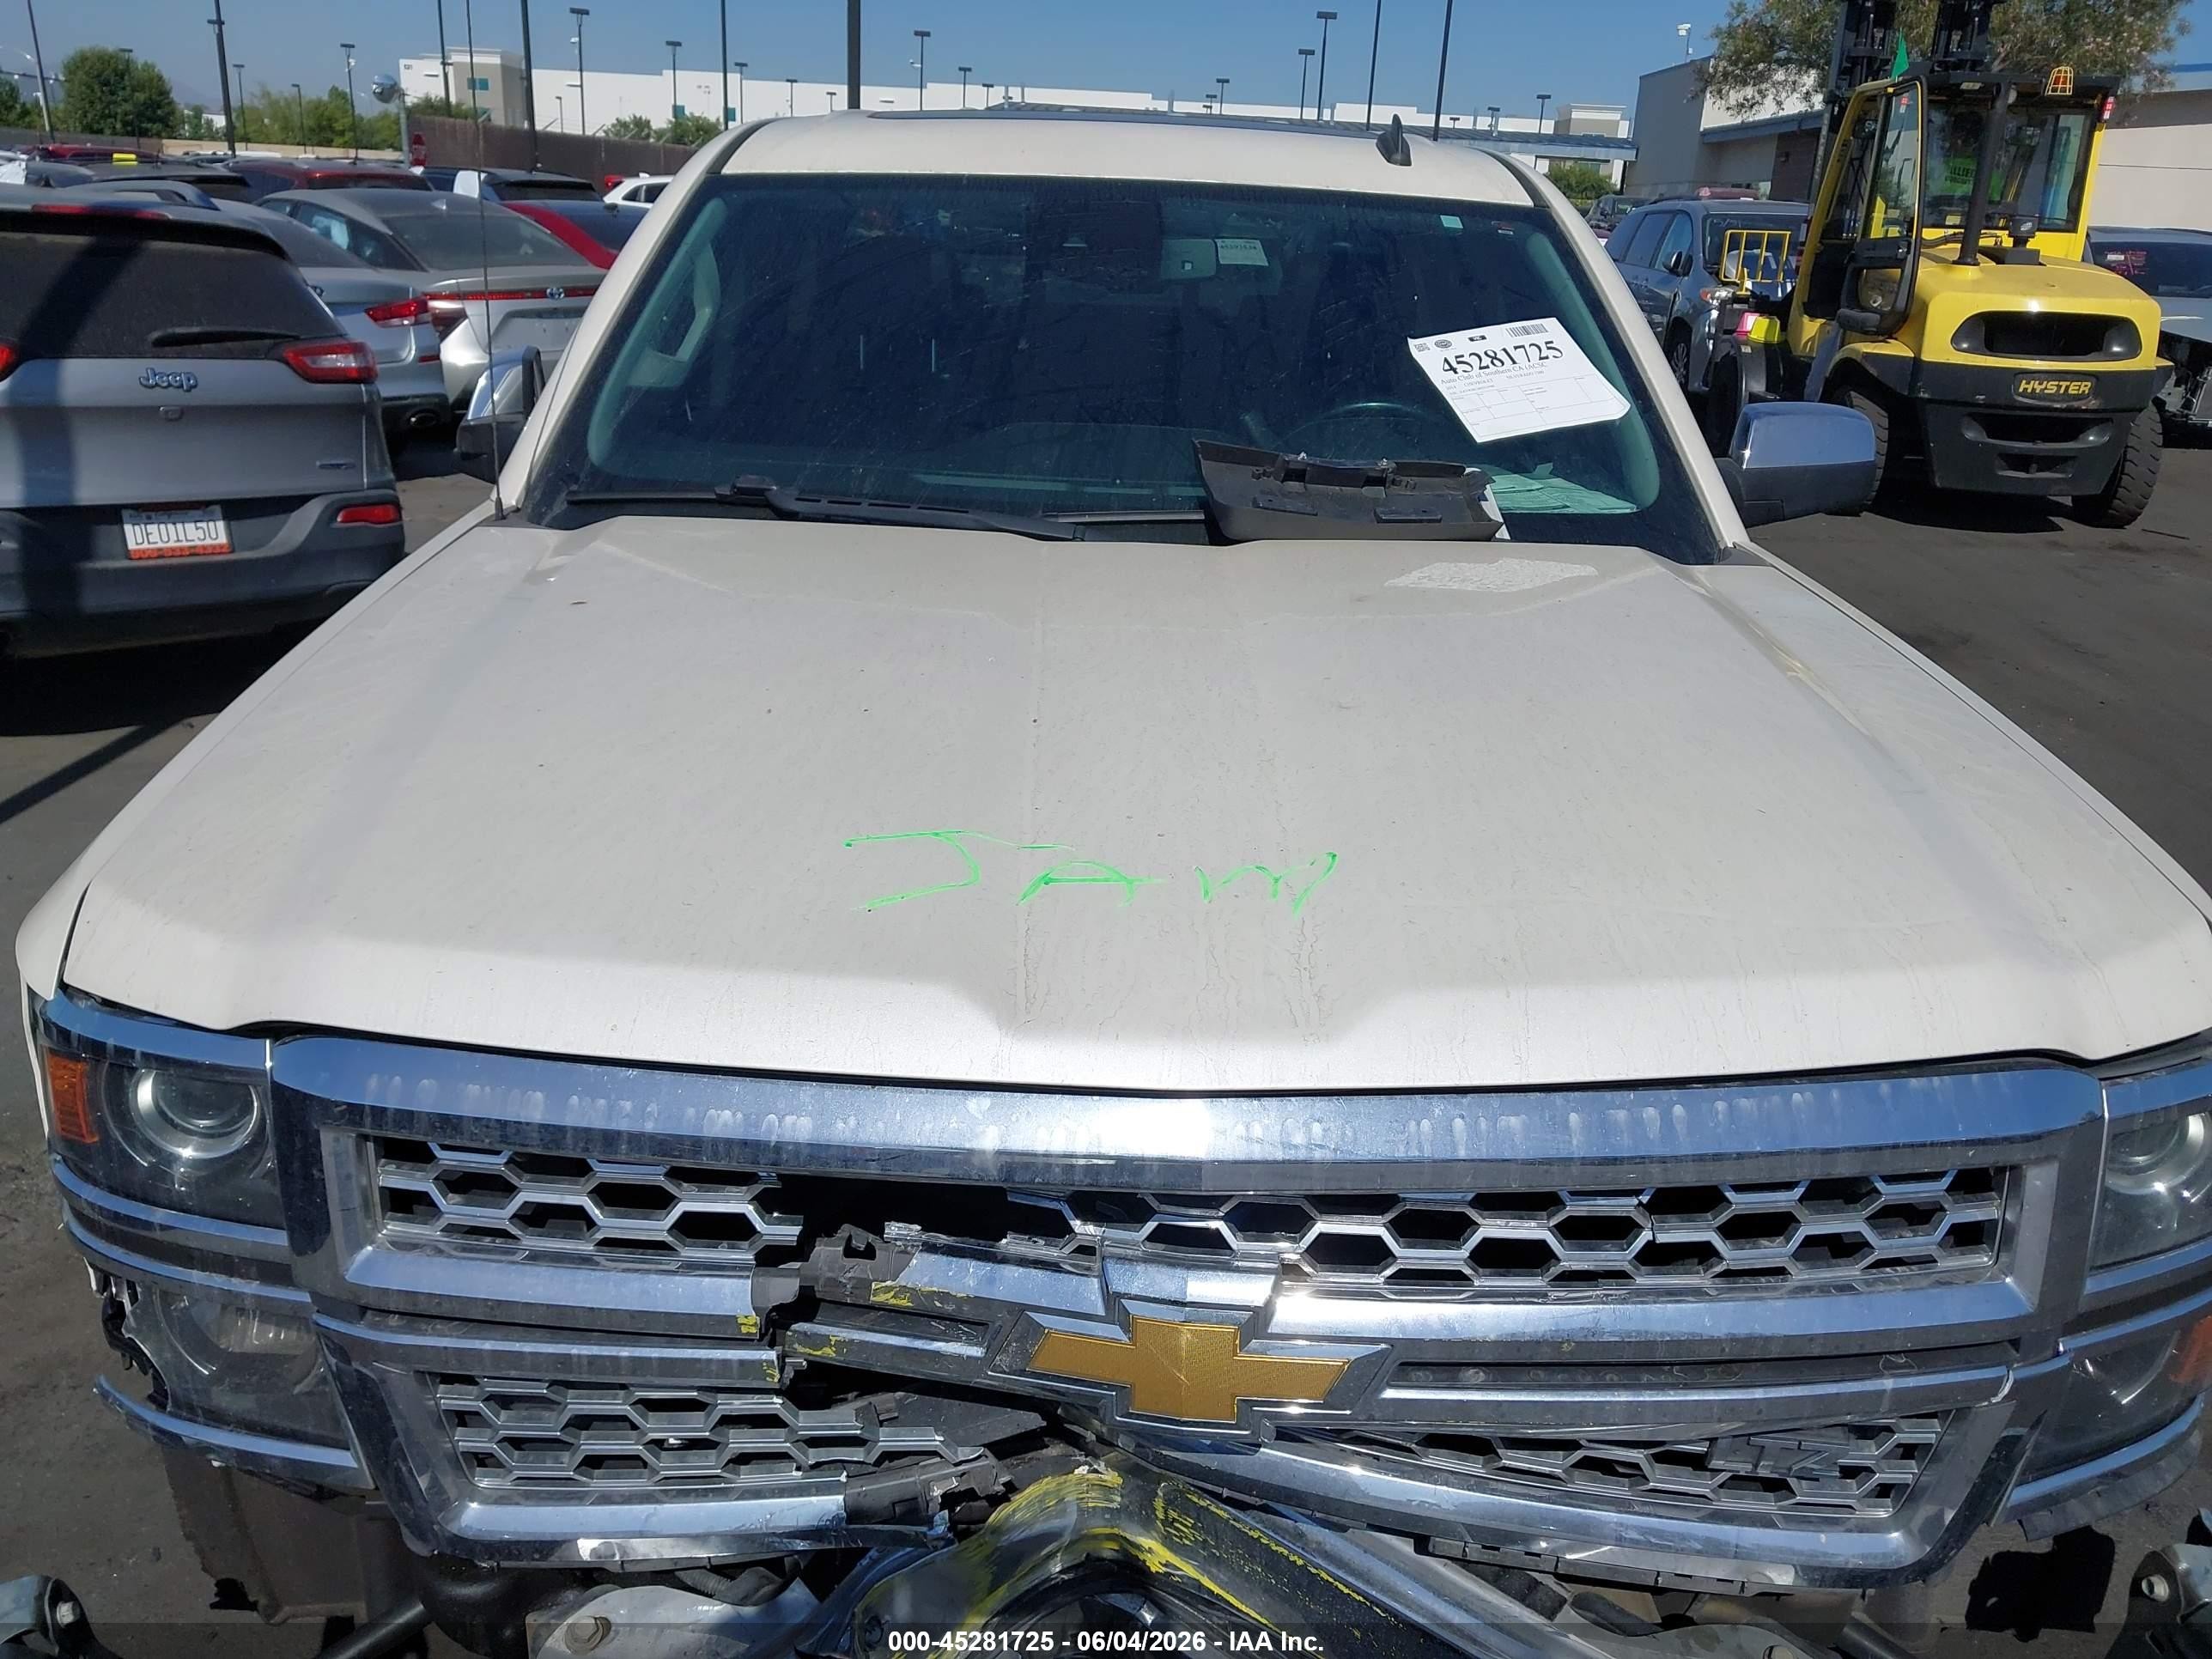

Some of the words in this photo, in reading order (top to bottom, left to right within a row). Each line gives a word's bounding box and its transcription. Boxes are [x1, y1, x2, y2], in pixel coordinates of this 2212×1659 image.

[1442, 341, 1564, 374] 45281725
[138, 367, 198, 392] Jeep
[2018, 380, 2092, 395] HYSTER
